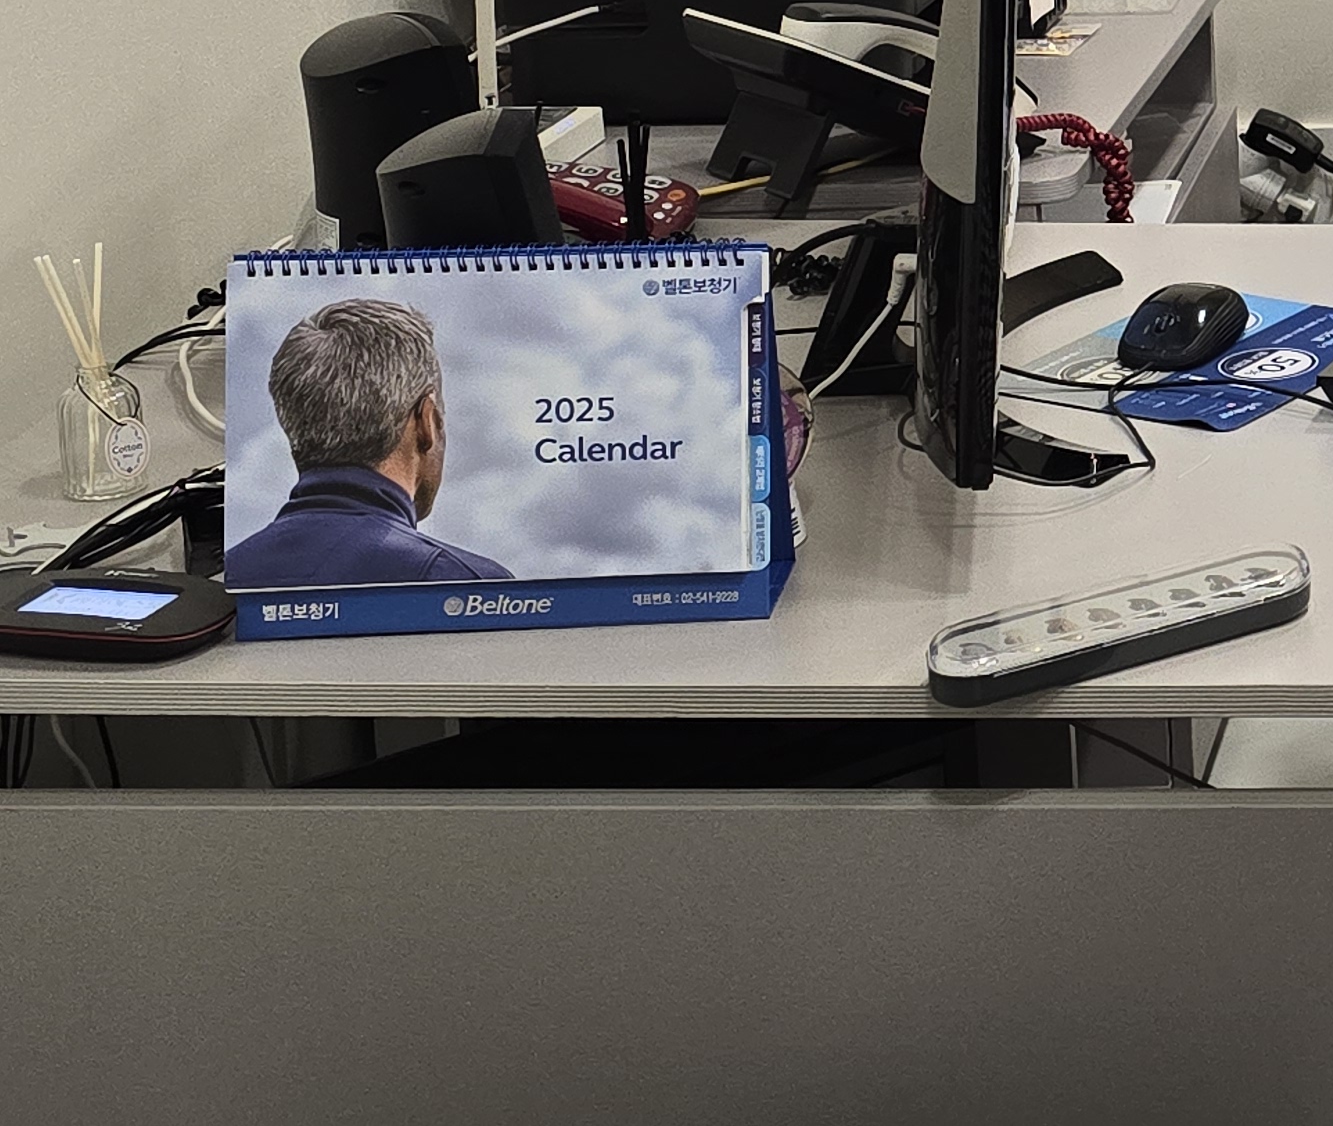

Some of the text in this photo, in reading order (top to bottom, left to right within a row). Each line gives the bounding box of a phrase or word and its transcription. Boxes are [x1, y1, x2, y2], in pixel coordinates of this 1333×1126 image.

[662, 277, 738, 295] 벨톤보청기
[535, 397, 615, 423] 2025
[535, 435, 684, 463] Calendar
[262, 602, 339, 622] 벨톤보청기
[464, 594, 552, 616] Beltone
